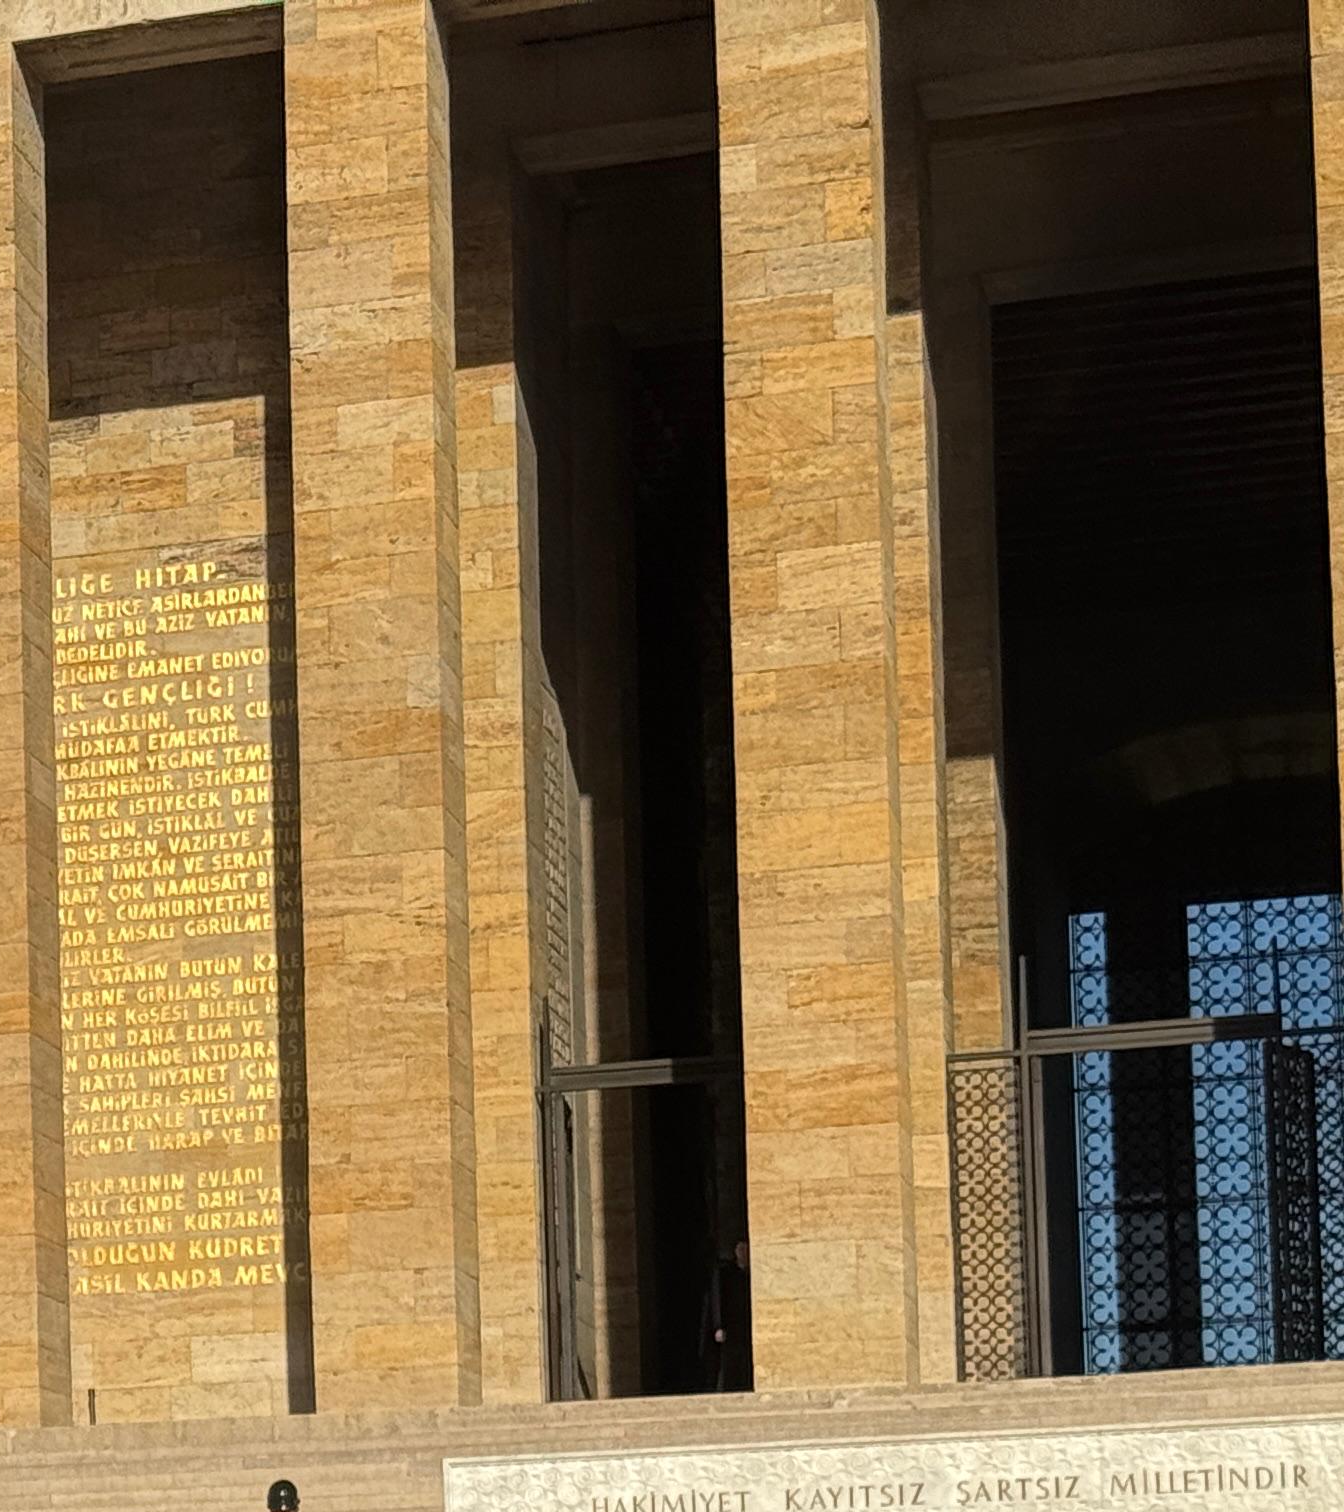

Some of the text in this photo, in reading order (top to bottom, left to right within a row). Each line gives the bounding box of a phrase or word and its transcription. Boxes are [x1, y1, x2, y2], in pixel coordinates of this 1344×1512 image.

[94, 620, 117, 641] VE
[123, 618, 147, 639] BU
[127, 655, 204, 679] EMANET
[57, 801, 119, 824] ETMEK
[234, 808, 258, 828] VE
[183, 855, 205, 875] VE
[84, 907, 108, 925] VE
[82, 1010, 118, 1030] HER
[241, 1018, 265, 1038] VE
[79, 1072, 137, 1094] HATTA
[136, 1267, 222, 1293] KANDA
[784, 1482, 926, 1511] KAYITSIZ
[956, 1475, 1080, 1506] ŞARTSIZ
